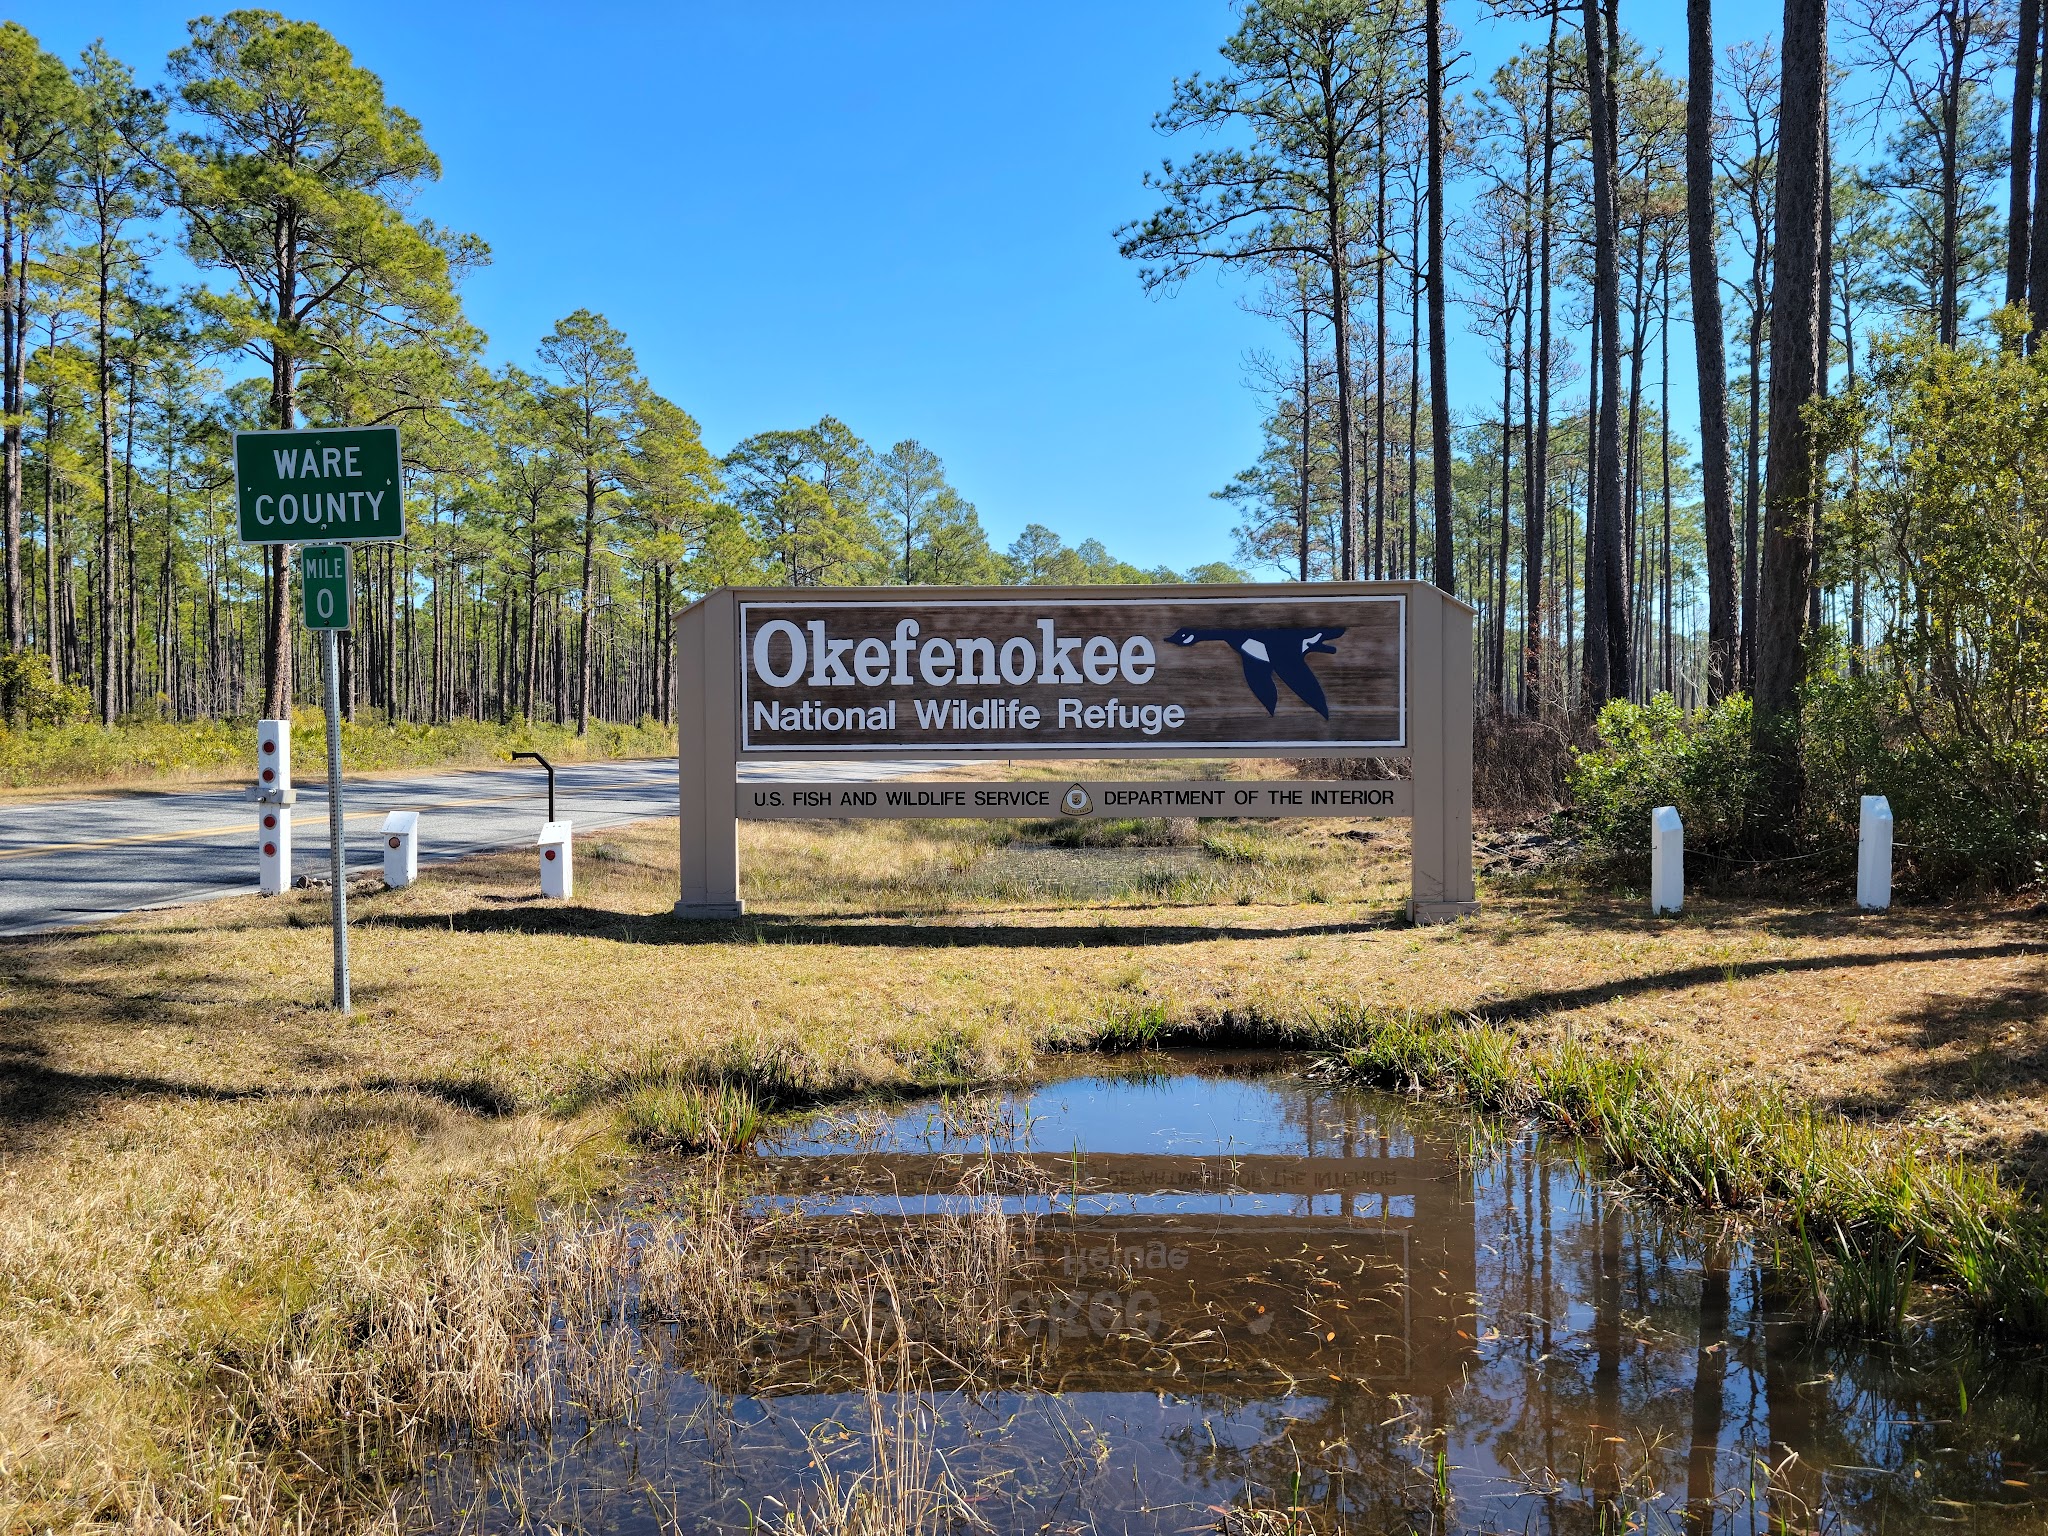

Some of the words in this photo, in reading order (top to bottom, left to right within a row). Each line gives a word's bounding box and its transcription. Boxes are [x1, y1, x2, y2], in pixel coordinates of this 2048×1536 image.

[273, 446, 363, 480] WARE
[255, 490, 385, 526] COUNTY
[306, 557, 343, 579] MILE
[316, 588, 334, 619] 0
[752, 618, 1157, 688] Okefenokee
[753, 700, 896, 731] National
[913, 698, 1041, 730] Wildlife
[1057, 697, 1186, 735] Refuge
[753, 791, 785, 807] U.S.
[793, 791, 832, 807] FISH
[839, 791, 878, 806] AND
[885, 790, 966, 806] WILDLIFE
[974, 790, 1050, 806] SERVICE
[1104, 789, 1226, 806] DEPARTMENT
[1234, 789, 1259, 806] OF
[1267, 789, 1307, 805] THE
[1310, 789, 1395, 806] INTERIOR
